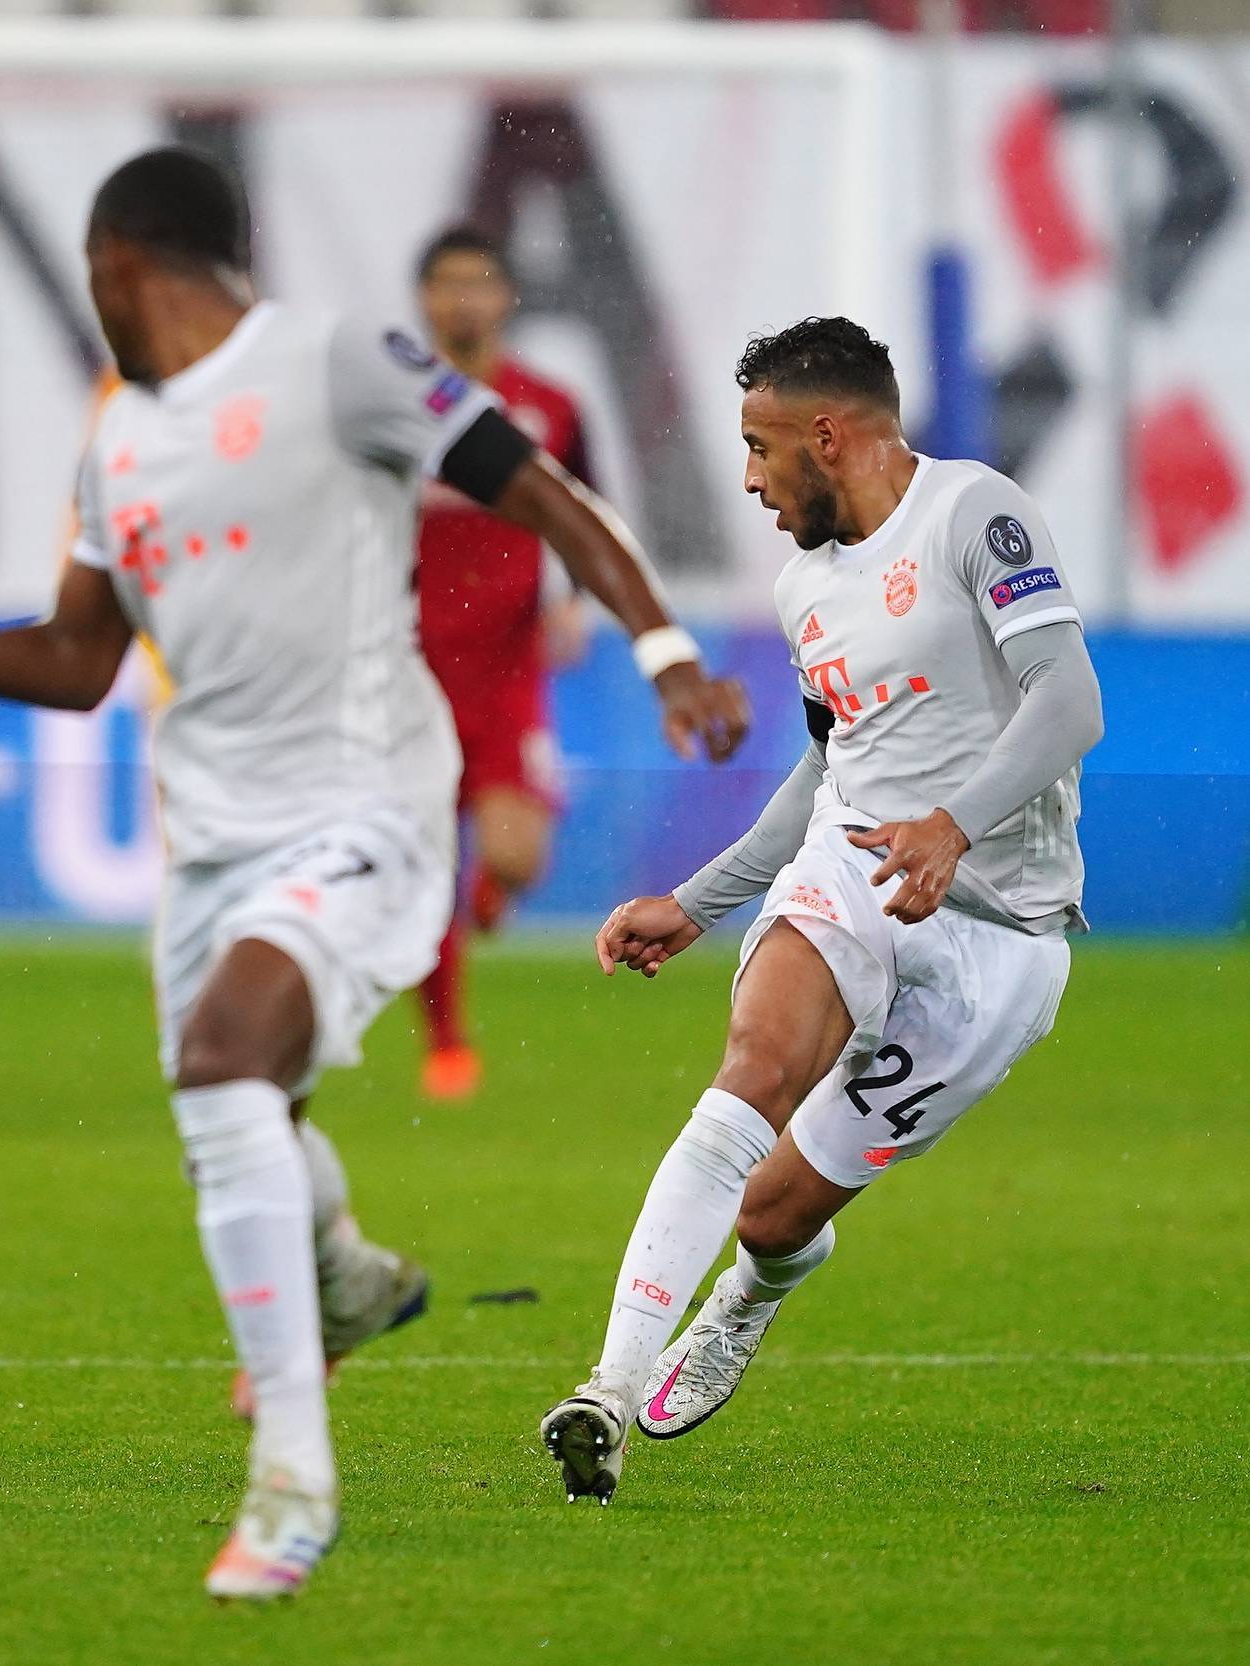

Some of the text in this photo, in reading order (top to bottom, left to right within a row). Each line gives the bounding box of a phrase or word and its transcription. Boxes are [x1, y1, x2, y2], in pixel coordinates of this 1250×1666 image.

[1009, 539, 1021, 553] 6
[1010, 572, 1058, 593] RESPECT
[844, 1044, 947, 1141] 24
[632, 1279, 672, 1306] FCB
